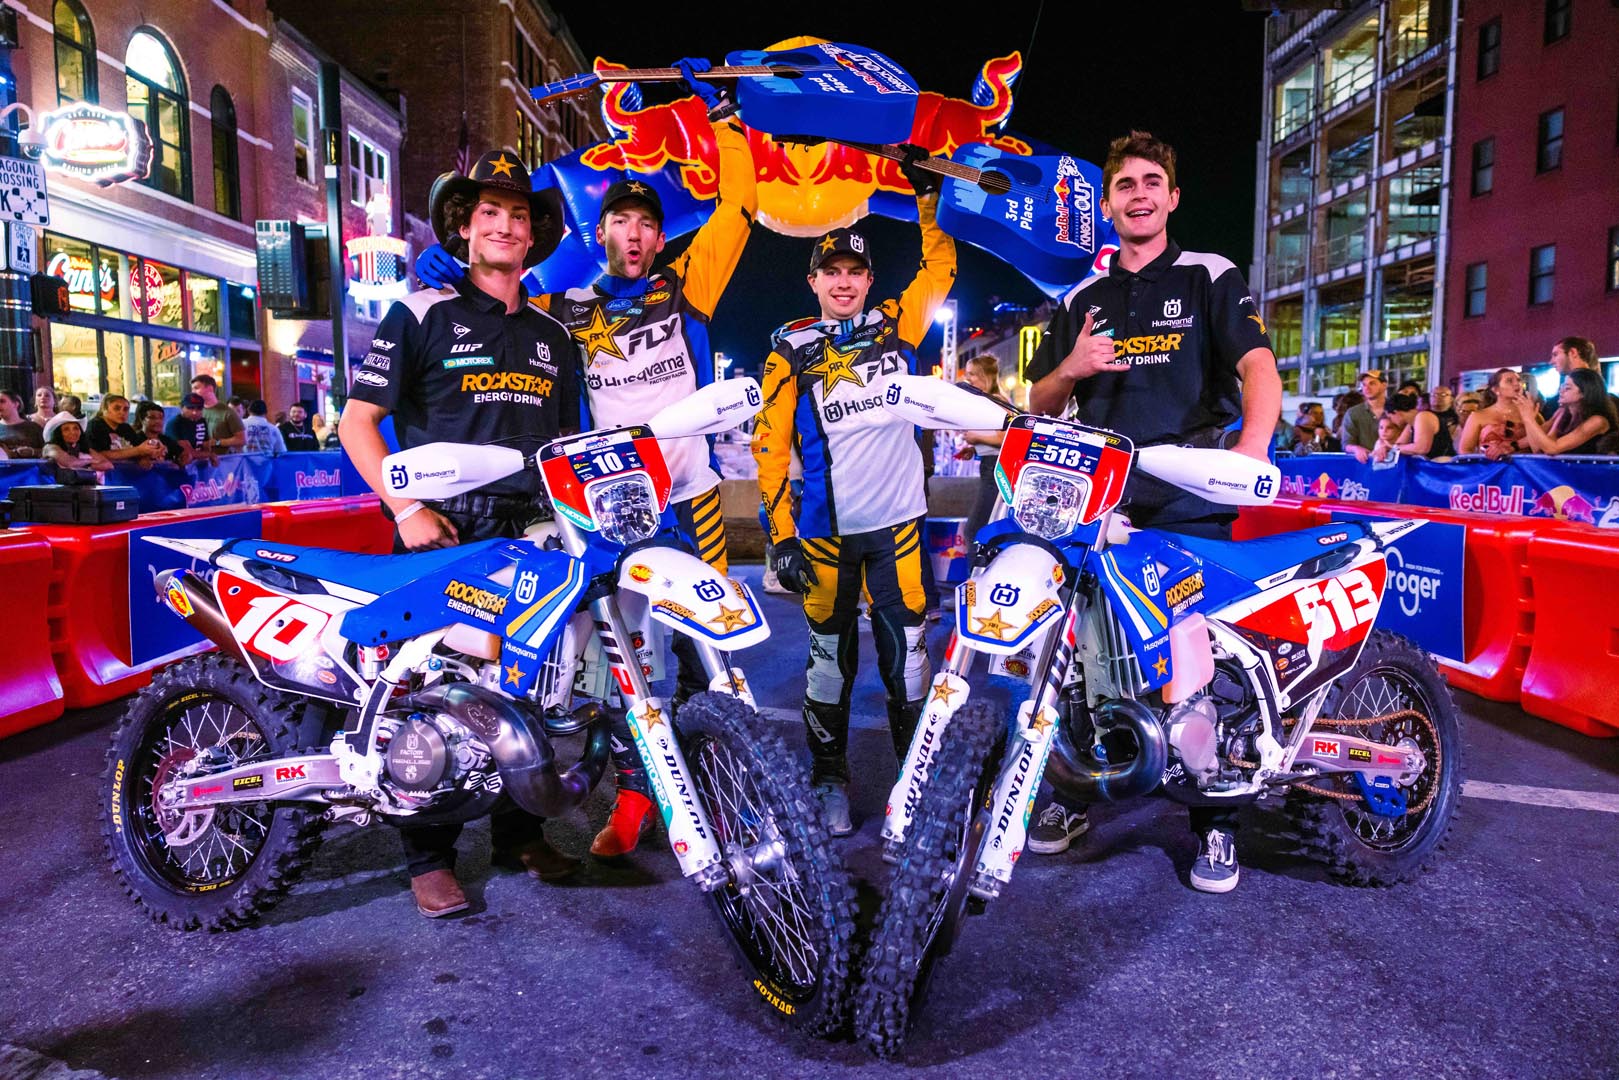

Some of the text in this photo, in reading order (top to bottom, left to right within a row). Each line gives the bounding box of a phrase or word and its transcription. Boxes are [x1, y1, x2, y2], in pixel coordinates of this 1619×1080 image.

[808, 77, 836, 92] 2nd
[822, 73, 854, 94] Place
[1005, 199, 1019, 221] 3rd
[1020, 197, 1034, 230] Place
[1152, 316, 1193, 328] Husqvarna
[628, 317, 679, 356] FLY
[1113, 333, 1184, 357] CKSTAR
[456, 357, 493, 367] MOTOREX
[529, 358, 559, 372] Husqvarna
[866, 355, 899, 384] FLY
[1135, 354, 1171, 365] DRINK
[461, 372, 553, 396] ROCKSTAR
[649, 375, 671, 386] FACTORY
[474, 392, 543, 407] ENERGY DRINK
[722, 400, 743, 414] Husqvarna
[910, 399, 935, 411] Husqvarna
[593, 452, 624, 475] 10
[1043, 444, 1081, 467] 513
[423, 470, 456, 478] Husqvarna
[1216, 480, 1247, 489] Husqvarna
[1319, 533, 1348, 544] GUTS
[257, 550, 296, 563] GUTS
[777, 555, 793, 571] FLY
[444, 580, 508, 614] ROCKSTAR
[1166, 571, 1205, 608] ROCKSTAR
[447, 599, 496, 624] ENERGY DRINK
[1172, 591, 1204, 616] ENERGY DRINK
[1294, 570, 1379, 641] 513
[233, 596, 330, 661] 10
[505, 642, 538, 660] Husqvarna
[1144, 635, 1169, 652] Husqvarna
[1315, 741, 1338, 754] RK
[234, 776, 262, 786] EXCEL
[276, 765, 305, 781] RK
[637, 739, 671, 810] MOTOREX
[904, 730, 935, 820] DUNLOP
[113, 759, 126, 824] DUNLOP
[664, 754, 707, 839] DUNLOP
[1000, 743, 1033, 835] DUNLOP
[753, 979, 793, 1015] DUNLOP
